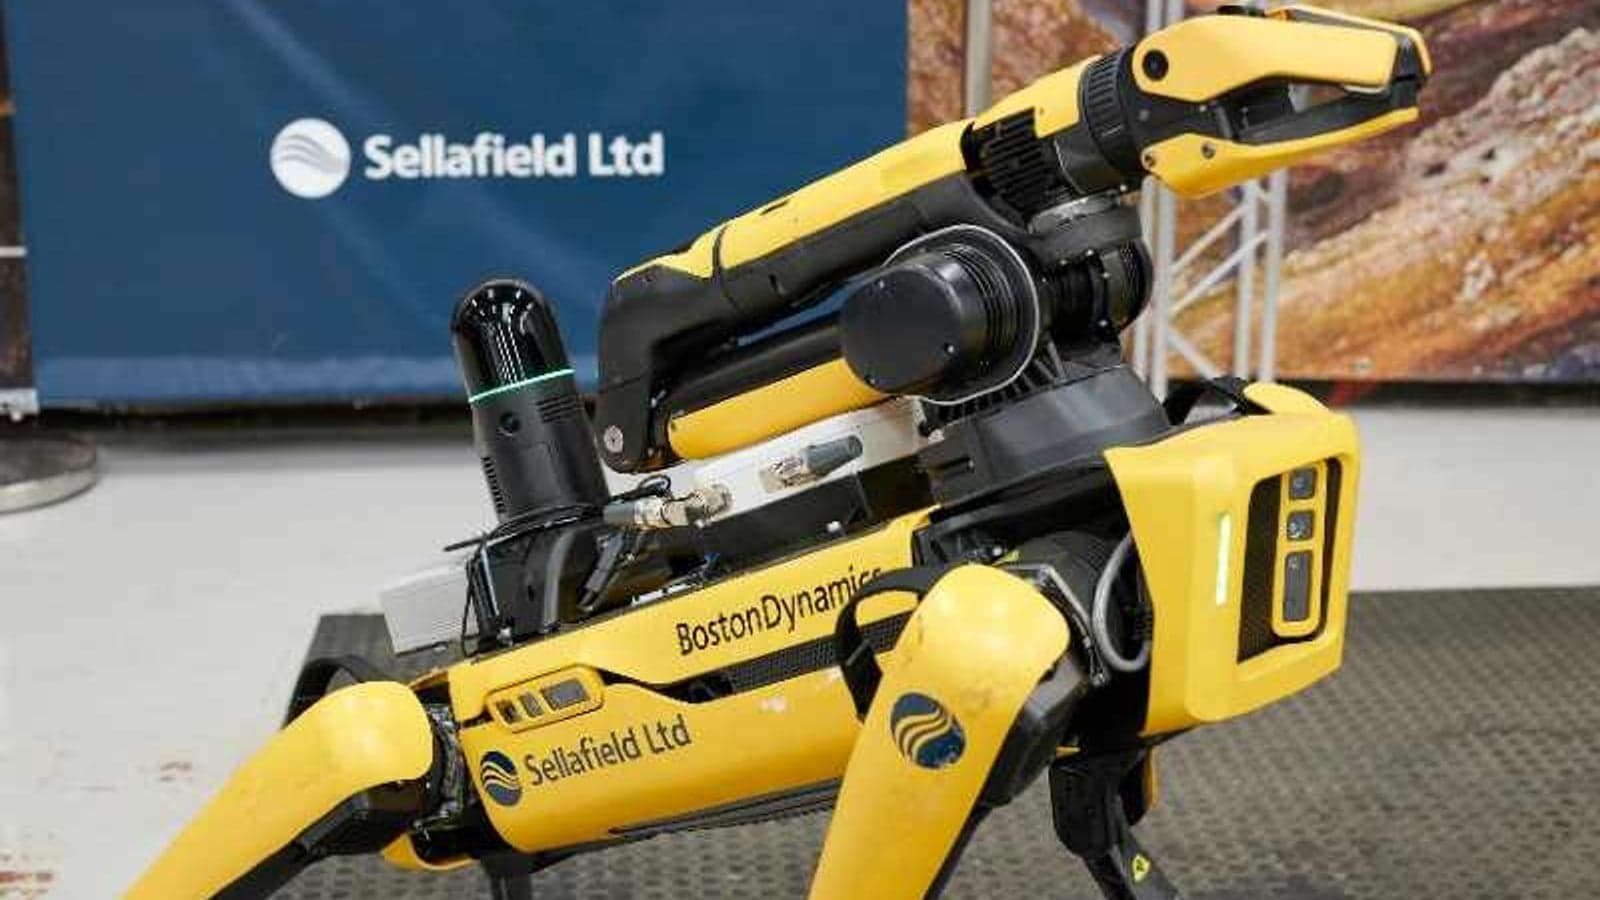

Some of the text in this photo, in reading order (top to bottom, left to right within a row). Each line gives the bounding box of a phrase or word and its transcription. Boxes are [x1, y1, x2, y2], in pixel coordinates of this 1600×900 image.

[364, 131, 665, 179] Sellafield Ltd
[523, 713, 692, 787] Sellafield Ltd
